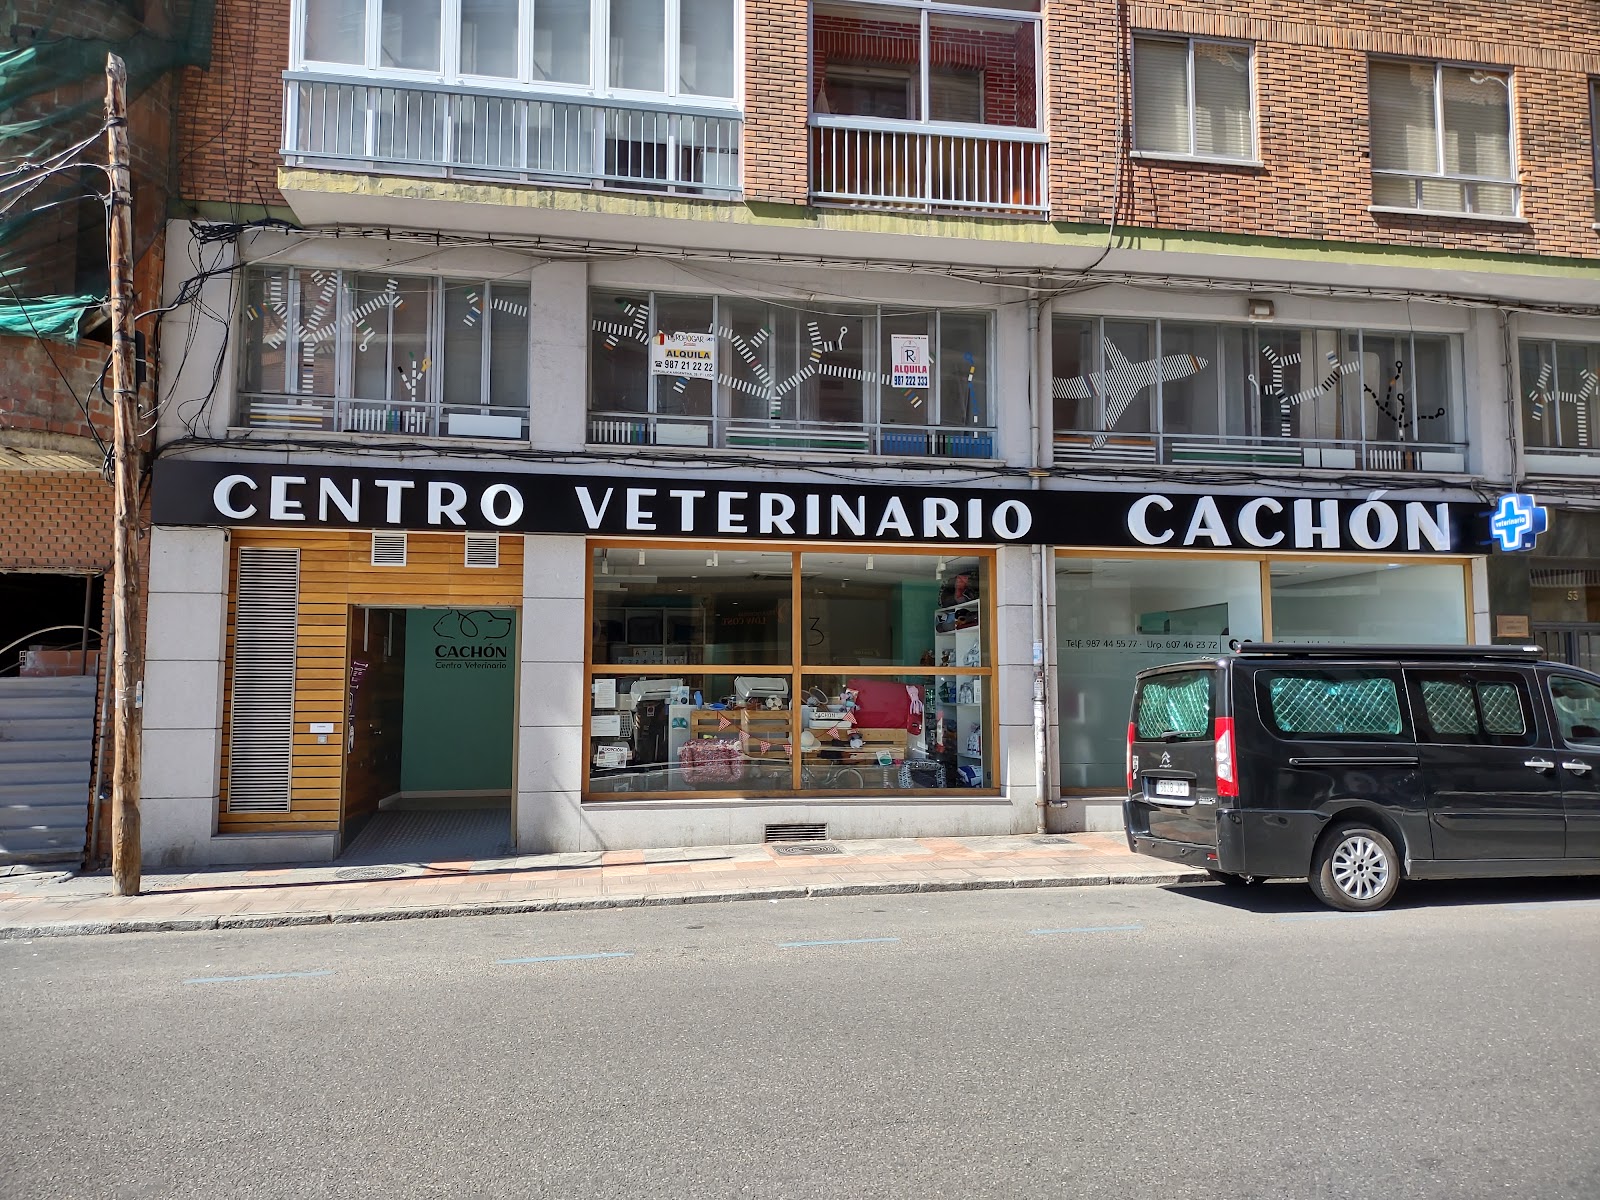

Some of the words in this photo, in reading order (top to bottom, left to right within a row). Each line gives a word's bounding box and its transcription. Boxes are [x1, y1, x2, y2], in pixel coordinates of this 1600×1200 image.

[666, 350, 711, 359] ALQUILA
[664, 360, 678, 369] 987
[681, 361, 690, 370] 21
[692, 362, 702, 371] 22
[704, 362, 713, 372] 22
[894, 365, 927, 374] ALQUILA
[894, 375, 904, 386] 987
[905, 375, 916, 386] 222
[917, 376, 928, 386] 333
[212, 474, 525, 527] CENTRO
[574, 486, 1034, 540] VETERINARIO
[1127, 489, 1452, 551] CACHÓN
[1495, 516, 1526, 528] veterinario
[1567, 590, 1579, 601] 53
[1086, 639, 1101, 648] 987
[1103, 640, 1115, 648] 44
[1116, 640, 1127, 648] 55
[1128, 640, 1138, 649] 77
[1165, 640, 1181, 649] 607
[1183, 641, 1194, 649] 46
[1196, 641, 1206, 649] 23
[1208, 641, 1218, 649] 72
[435, 643, 507, 658] CACHÓN
[435, 661, 462, 669] Centro
[464, 661, 507, 669] Veterinario
